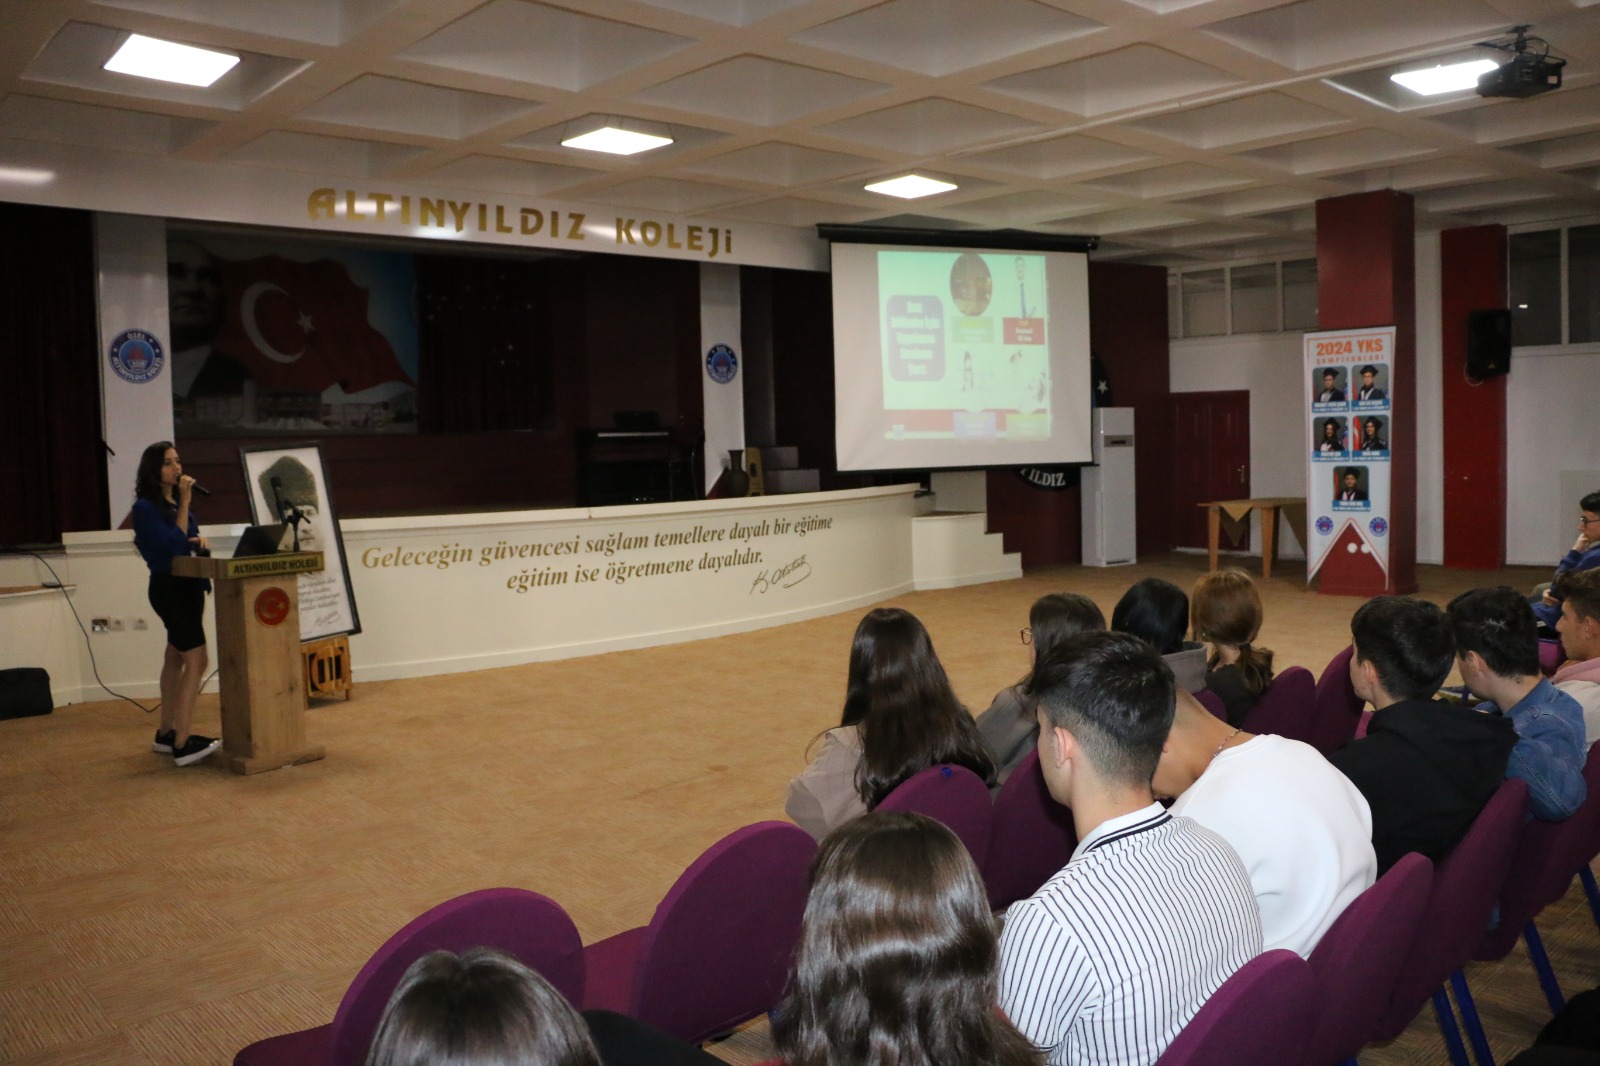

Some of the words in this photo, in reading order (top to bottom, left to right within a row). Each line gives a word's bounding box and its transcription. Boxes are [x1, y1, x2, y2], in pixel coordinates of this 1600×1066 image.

[307, 187, 586, 241] ALTINYILDIZ
[1316, 340, 1353, 355] 2024
[1357, 338, 1384, 353] YKS
[362, 543, 473, 570] Geleceğin
[479, 535, 580, 567] güvencesi
[585, 532, 648, 557] sağlam
[654, 525, 726, 548] temellere
[729, 519, 770, 543] dayalı
[773, 517, 791, 535] bir
[794, 514, 833, 537] eğitime
[507, 567, 568, 594] eğitim
[575, 564, 600, 583] ise
[605, 558, 694, 585] öğretmene
[698, 548, 763, 573] dayalıdır.
